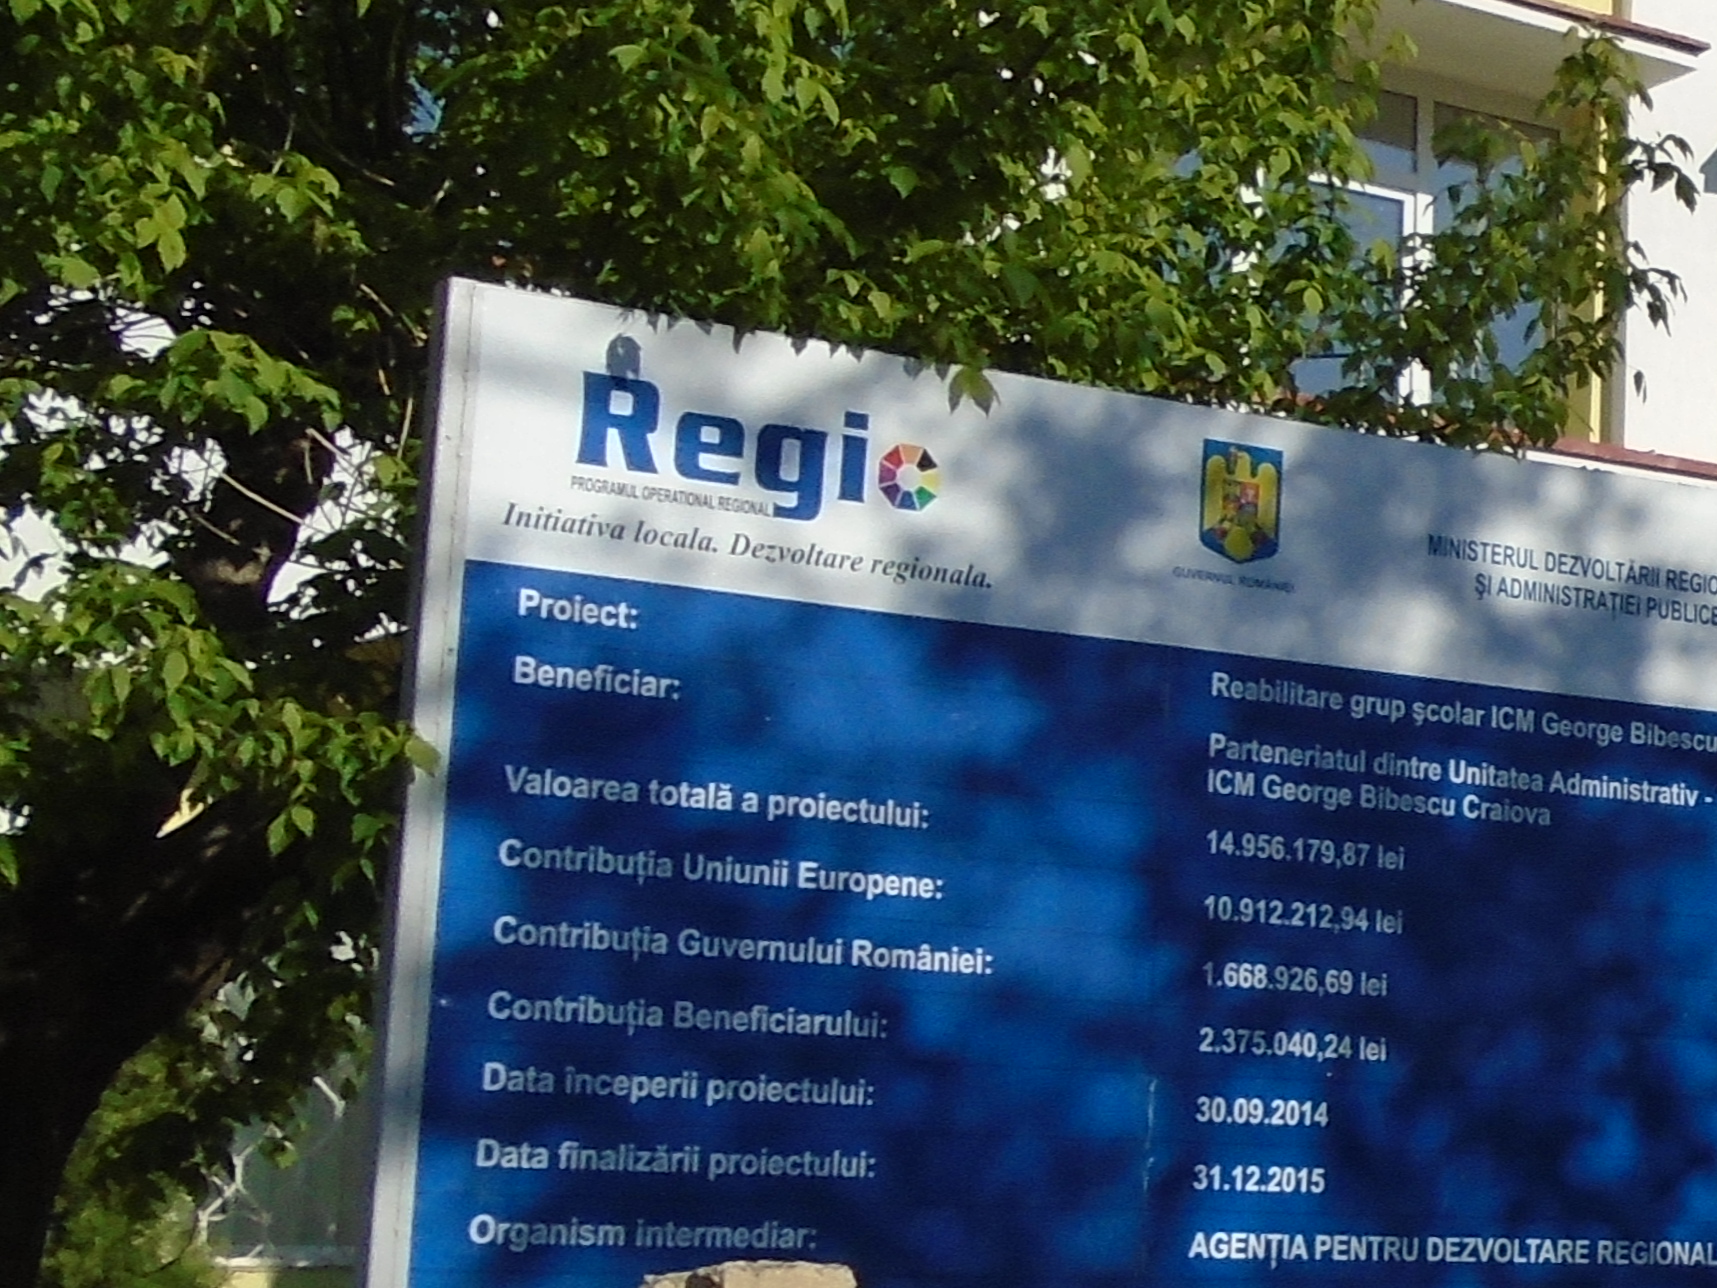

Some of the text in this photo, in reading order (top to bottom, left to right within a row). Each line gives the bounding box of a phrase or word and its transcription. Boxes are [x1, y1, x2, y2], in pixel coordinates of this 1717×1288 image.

[570, 475, 639, 500] PROGRAMUL
[718, 497, 772, 518] REGIONAL
[502, 501, 993, 590] Initiativa locala. Dezvoltare regionala.
[1427, 533, 1538, 572] MINISTERUL
[1544, 550, 1661, 590] DEZVOLTĂRII
[517, 588, 639, 630] Proiect:
[513, 655, 681, 701] Beneficiar:
[1211, 671, 1343, 711] Reabilitare
[1350, 695, 1406, 722] grup
[1491, 706, 1535, 733] ICM
[1541, 713, 1624, 746] George
[1208, 733, 1366, 774] Parteneriatul
[1373, 753, 1443, 782] dintre
[1448, 760, 1543, 793] Unitatea
[1548, 771, 1699, 809] Administrativ
[504, 764, 929, 830] Valoarea totală a proiectului:
[1206, 768, 1553, 827] ICM George Bibescu Craiova
[1206, 829, 1405, 871] 14.956.179,87 lei
[683, 852, 788, 888] Uniunii
[797, 861, 944, 901] Europene:
[1204, 894, 1403, 935] 10.912.212,94 lei
[678, 928, 844, 966] Guvernului
[851, 939, 993, 976] României:
[1201, 961, 1388, 997] 1.668.926,69 lei
[673, 1001, 887, 1038] Beneficiarului:
[1198, 1026, 1387, 1062] 2.375.040,24 lei
[482, 1062, 875, 1107] Data începerii proiectului:
[1195, 1096, 1329, 1127] 30.09.2014
[476, 1138, 876, 1179] Data finalizării proiectului:
[1192, 1164, 1326, 1194] 31.12.2015
[469, 1215, 817, 1252] Organism intermediar:
[1314, 1233, 1419, 1261] PENTRU
[1425, 1236, 1590, 1264] DEZVOLTARE
